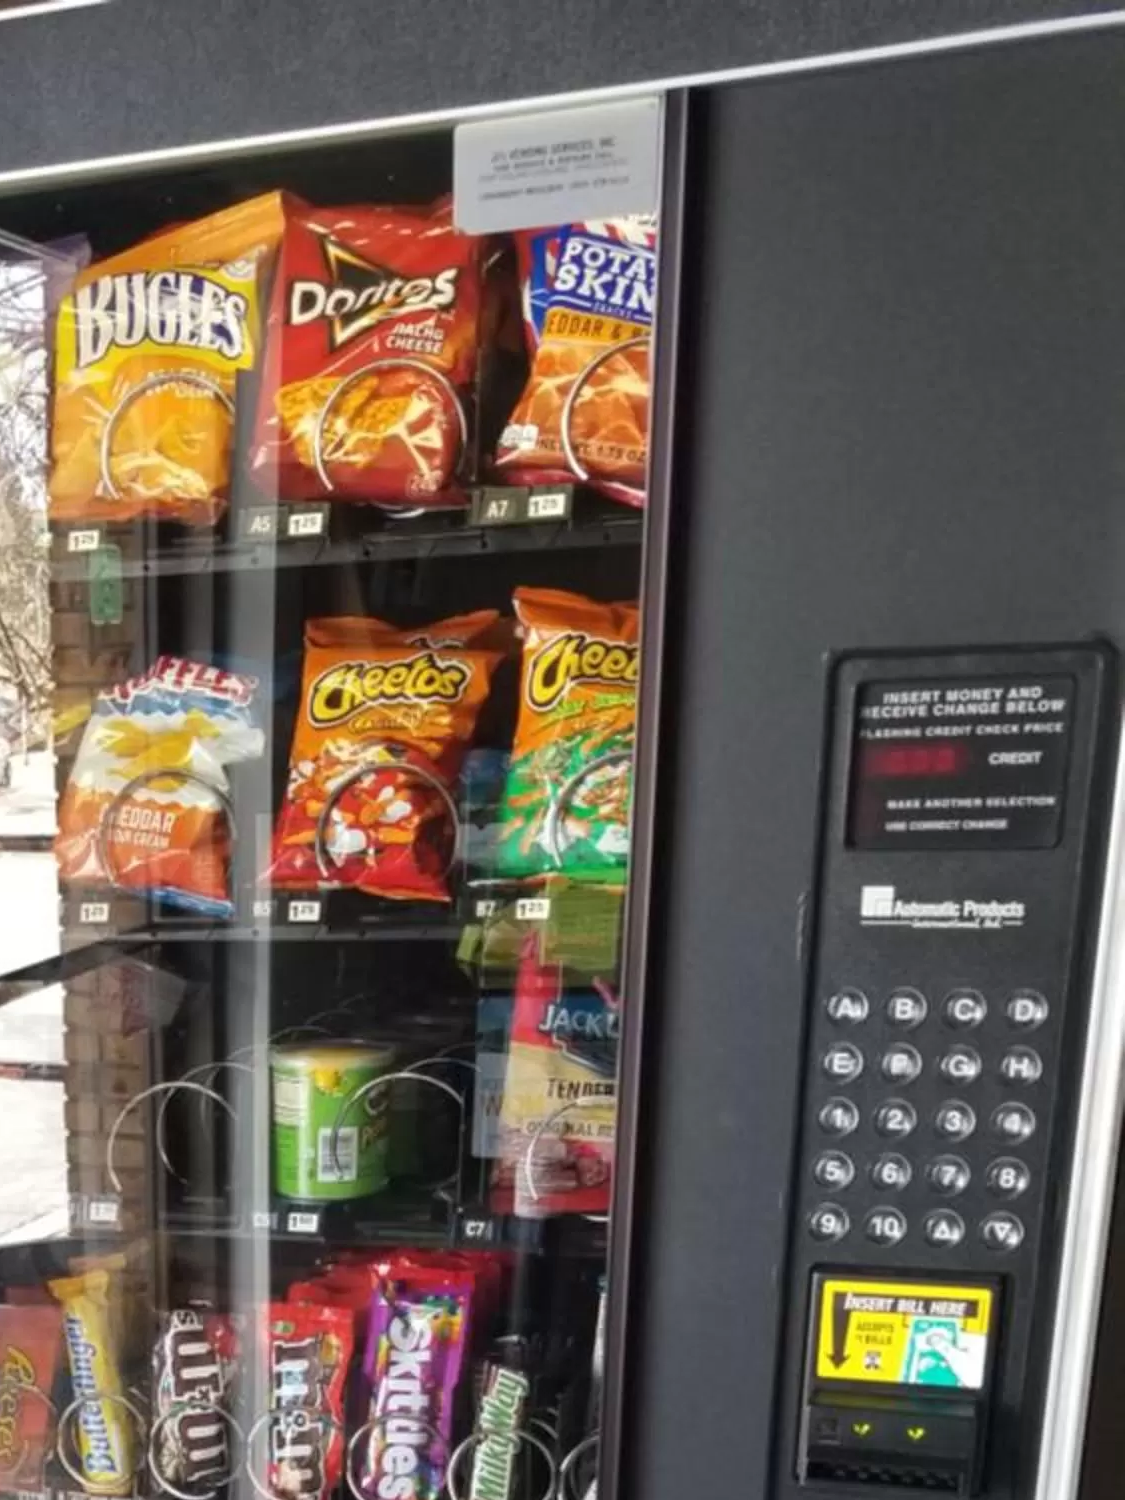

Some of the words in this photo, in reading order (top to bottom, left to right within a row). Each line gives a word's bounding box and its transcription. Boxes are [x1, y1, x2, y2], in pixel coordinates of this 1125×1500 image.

[561, 237, 656, 282] POTA
[290, 267, 459, 326] Doritos
[75, 270, 249, 369] BUGLES
[385, 334, 443, 353] CHEESE
[486, 500, 509, 518] A7
[250, 514, 271, 534] A5
[310, 651, 468, 725] Cheetos
[883, 690, 942, 705] INSERT
[946, 688, 1003, 702] MONEY
[1007, 686, 1043, 700] AND
[861, 705, 928, 719] RECEIVE
[933, 702, 1000, 717] CHANGE
[1006, 699, 1066, 714] BELOW
[1024, 721, 1064, 734] PRICE
[988, 751, 1043, 765] CREDIT
[836, 998, 856, 1018] A
[895, 998, 914, 1019] B
[954, 998, 974, 1021] C
[1015, 999, 1035, 1022] D
[539, 1003, 604, 1039] JACK
[833, 1053, 851, 1074] E
[949, 1054, 970, 1076] G
[1009, 1056, 1028, 1077] H
[887, 1109, 904, 1130] 2
[944, 1110, 962, 1131] 3
[1004, 1113, 1021, 1133] 4
[825, 1161, 841, 1181] 5
[881, 1162, 898, 1184] 6
[940, 1165, 957, 1186] 7
[998, 1167, 1016, 1189] 8
[820, 1213, 836, 1234] 9
[873, 1216, 899, 1236] 10
[843, 1291, 894, 1312] INSERT
[896, 1297, 926, 1314] BILL
[930, 1299, 968, 1316] HERE
[481, 1368, 529, 1431] Way
